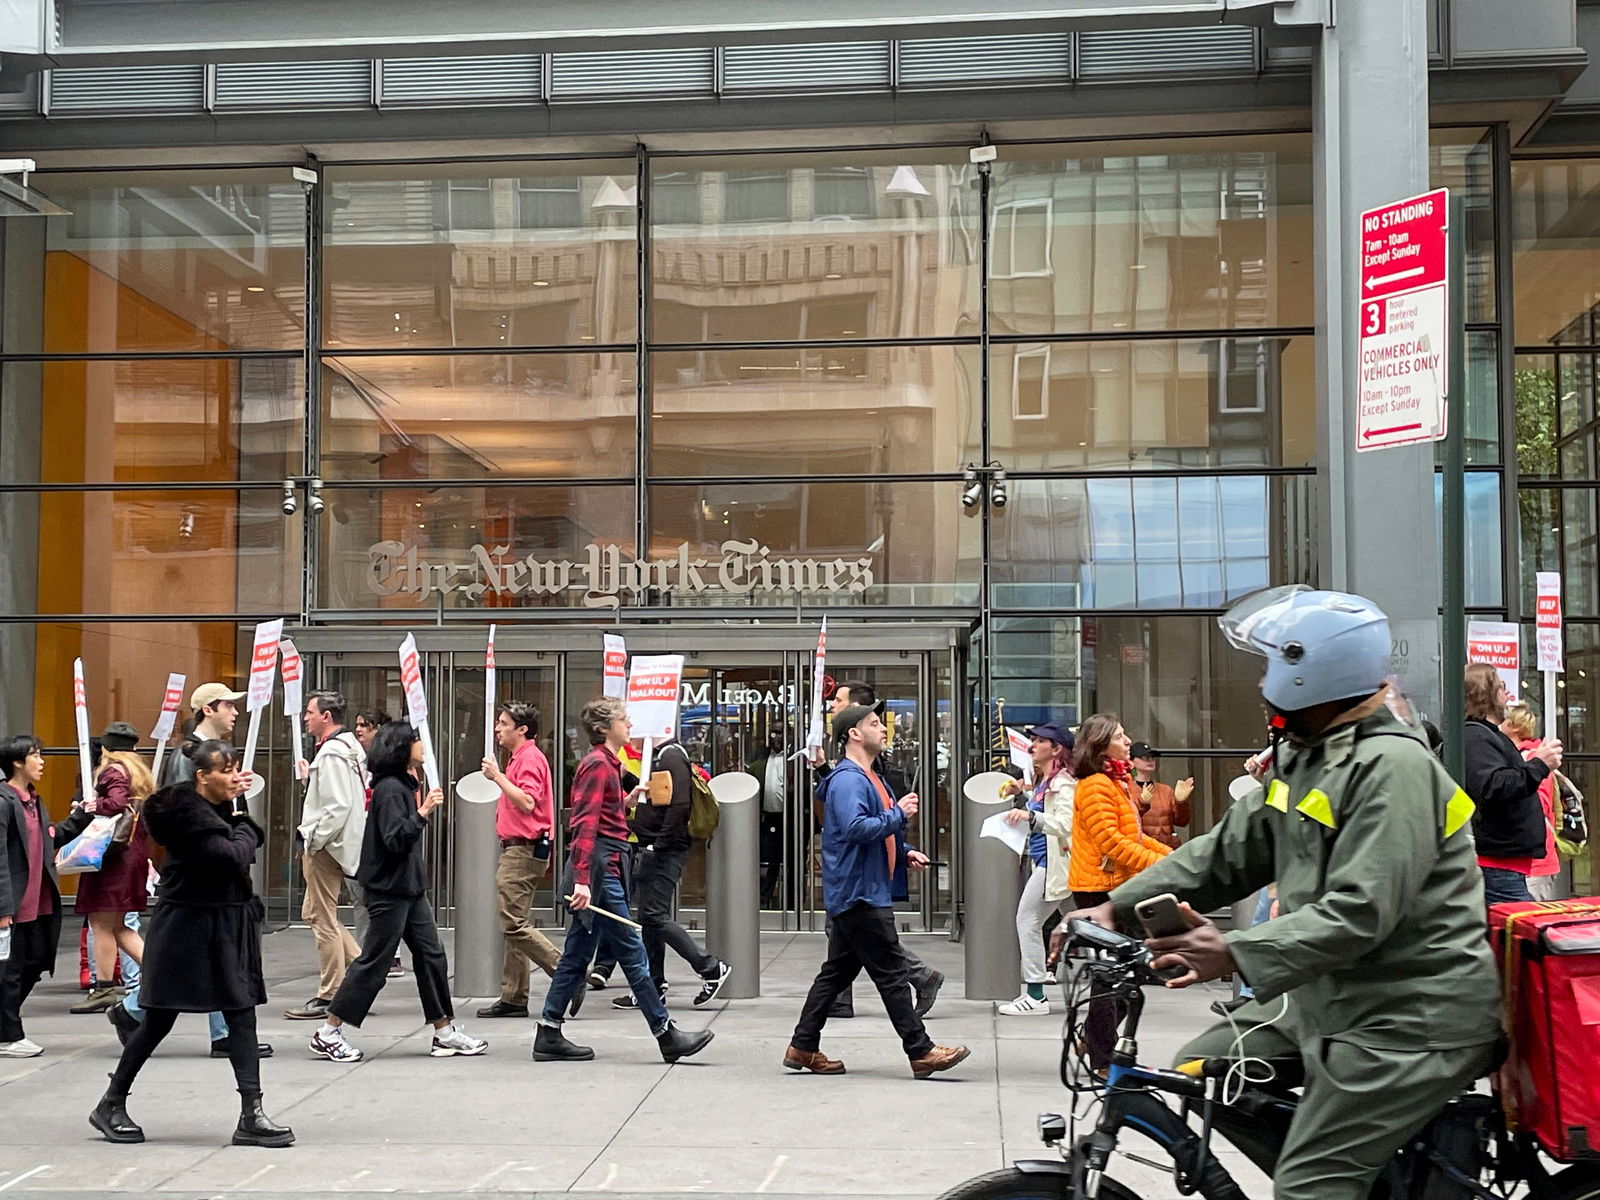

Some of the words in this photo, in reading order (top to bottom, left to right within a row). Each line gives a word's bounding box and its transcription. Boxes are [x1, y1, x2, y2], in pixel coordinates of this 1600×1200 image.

[1365, 216, 1379, 233] NO
[1382, 200, 1433, 228] STANDING
[1365, 240, 1382, 253] 7am
[1388, 232, 1409, 246] 10am
[1364, 249, 1390, 267] Except
[1392, 243, 1421, 260] Sunday
[1389, 299, 1404, 309] hour
[1366, 303, 1380, 334] 3
[1389, 306, 1418, 321] metered
[1389, 321, 1414, 335] parking
[1364, 360, 1410, 382] VEHICLES
[1414, 354, 1440, 372] ONLY
[1363, 390, 1382, 402] 10am
[1391, 384, 1411, 398] 10pm
[1362, 401, 1388, 416] Except
[1391, 398, 1421, 412] Sunday
[366, 540, 461, 602] The
[466, 543, 575, 601] New
[582, 541, 709, 610] York
[718, 537, 874, 595] Times
[1477, 643, 1492, 653] ON
[1493, 644, 1511, 654] ULP
[1471, 654, 1517, 666] WALKOUT
[636, 678, 650, 686] ON
[651, 676, 671, 686] ULP
[630, 688, 676, 698] WALKOUT
